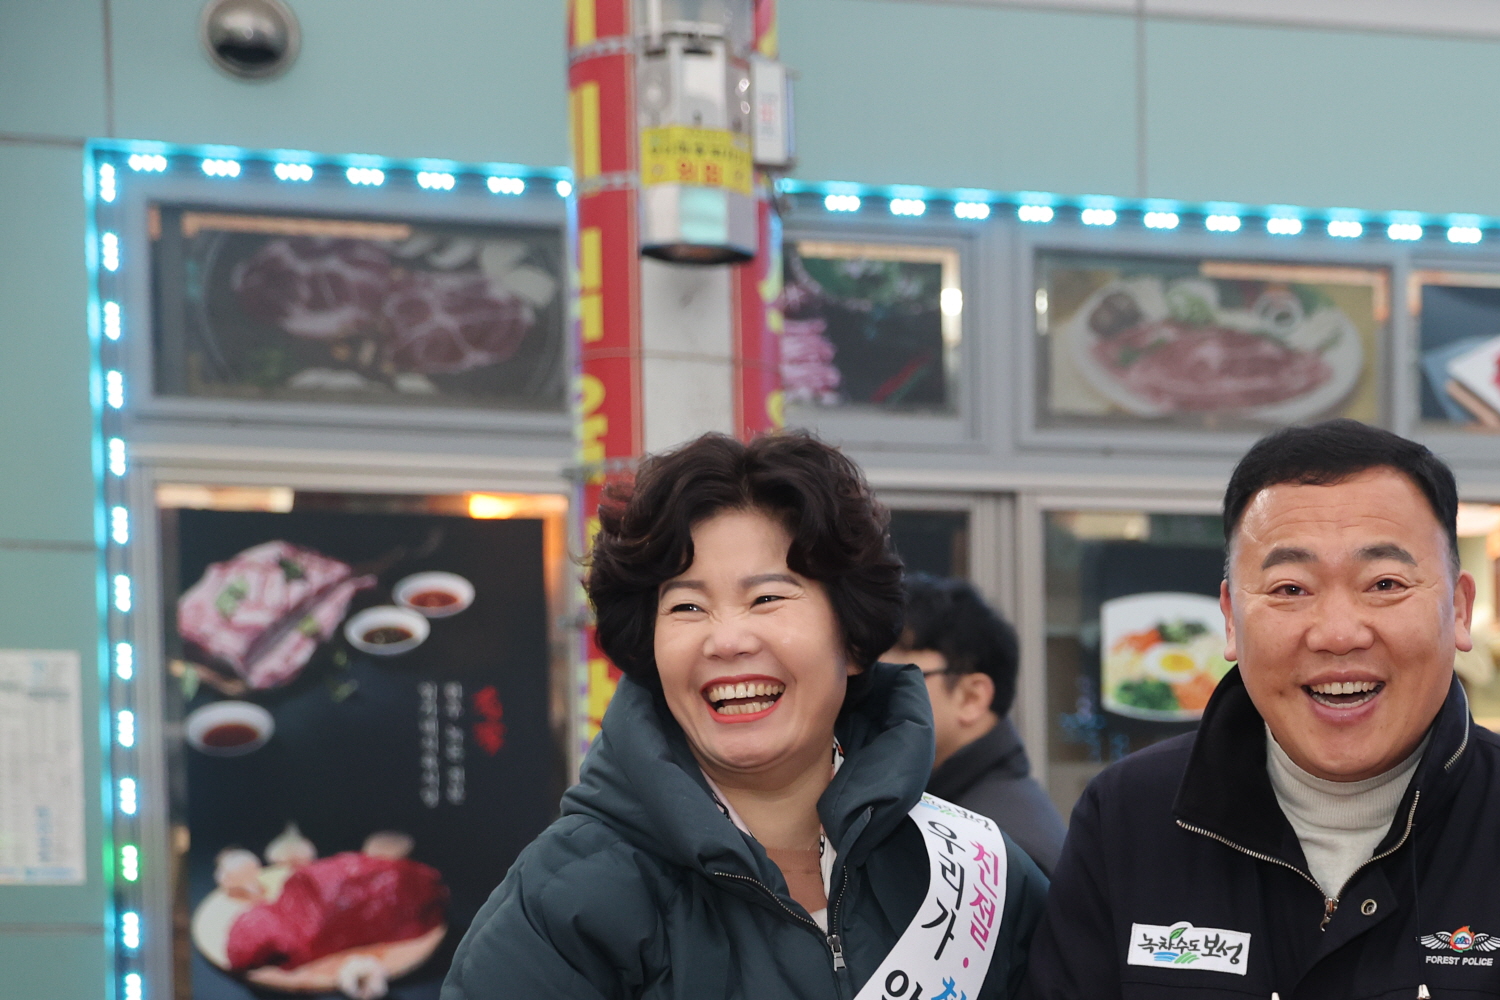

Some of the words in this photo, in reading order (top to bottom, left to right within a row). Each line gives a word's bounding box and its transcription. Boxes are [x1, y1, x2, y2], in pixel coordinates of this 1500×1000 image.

[921, 820, 966, 961] 우리가
[969, 840, 999, 951] 친절
[1138, 930, 1201, 955] 녹차수도
[1201, 933, 1243, 965] 보성
[1425, 955, 1460, 966] FOREST
[1462, 957, 1494, 966] POLICE
